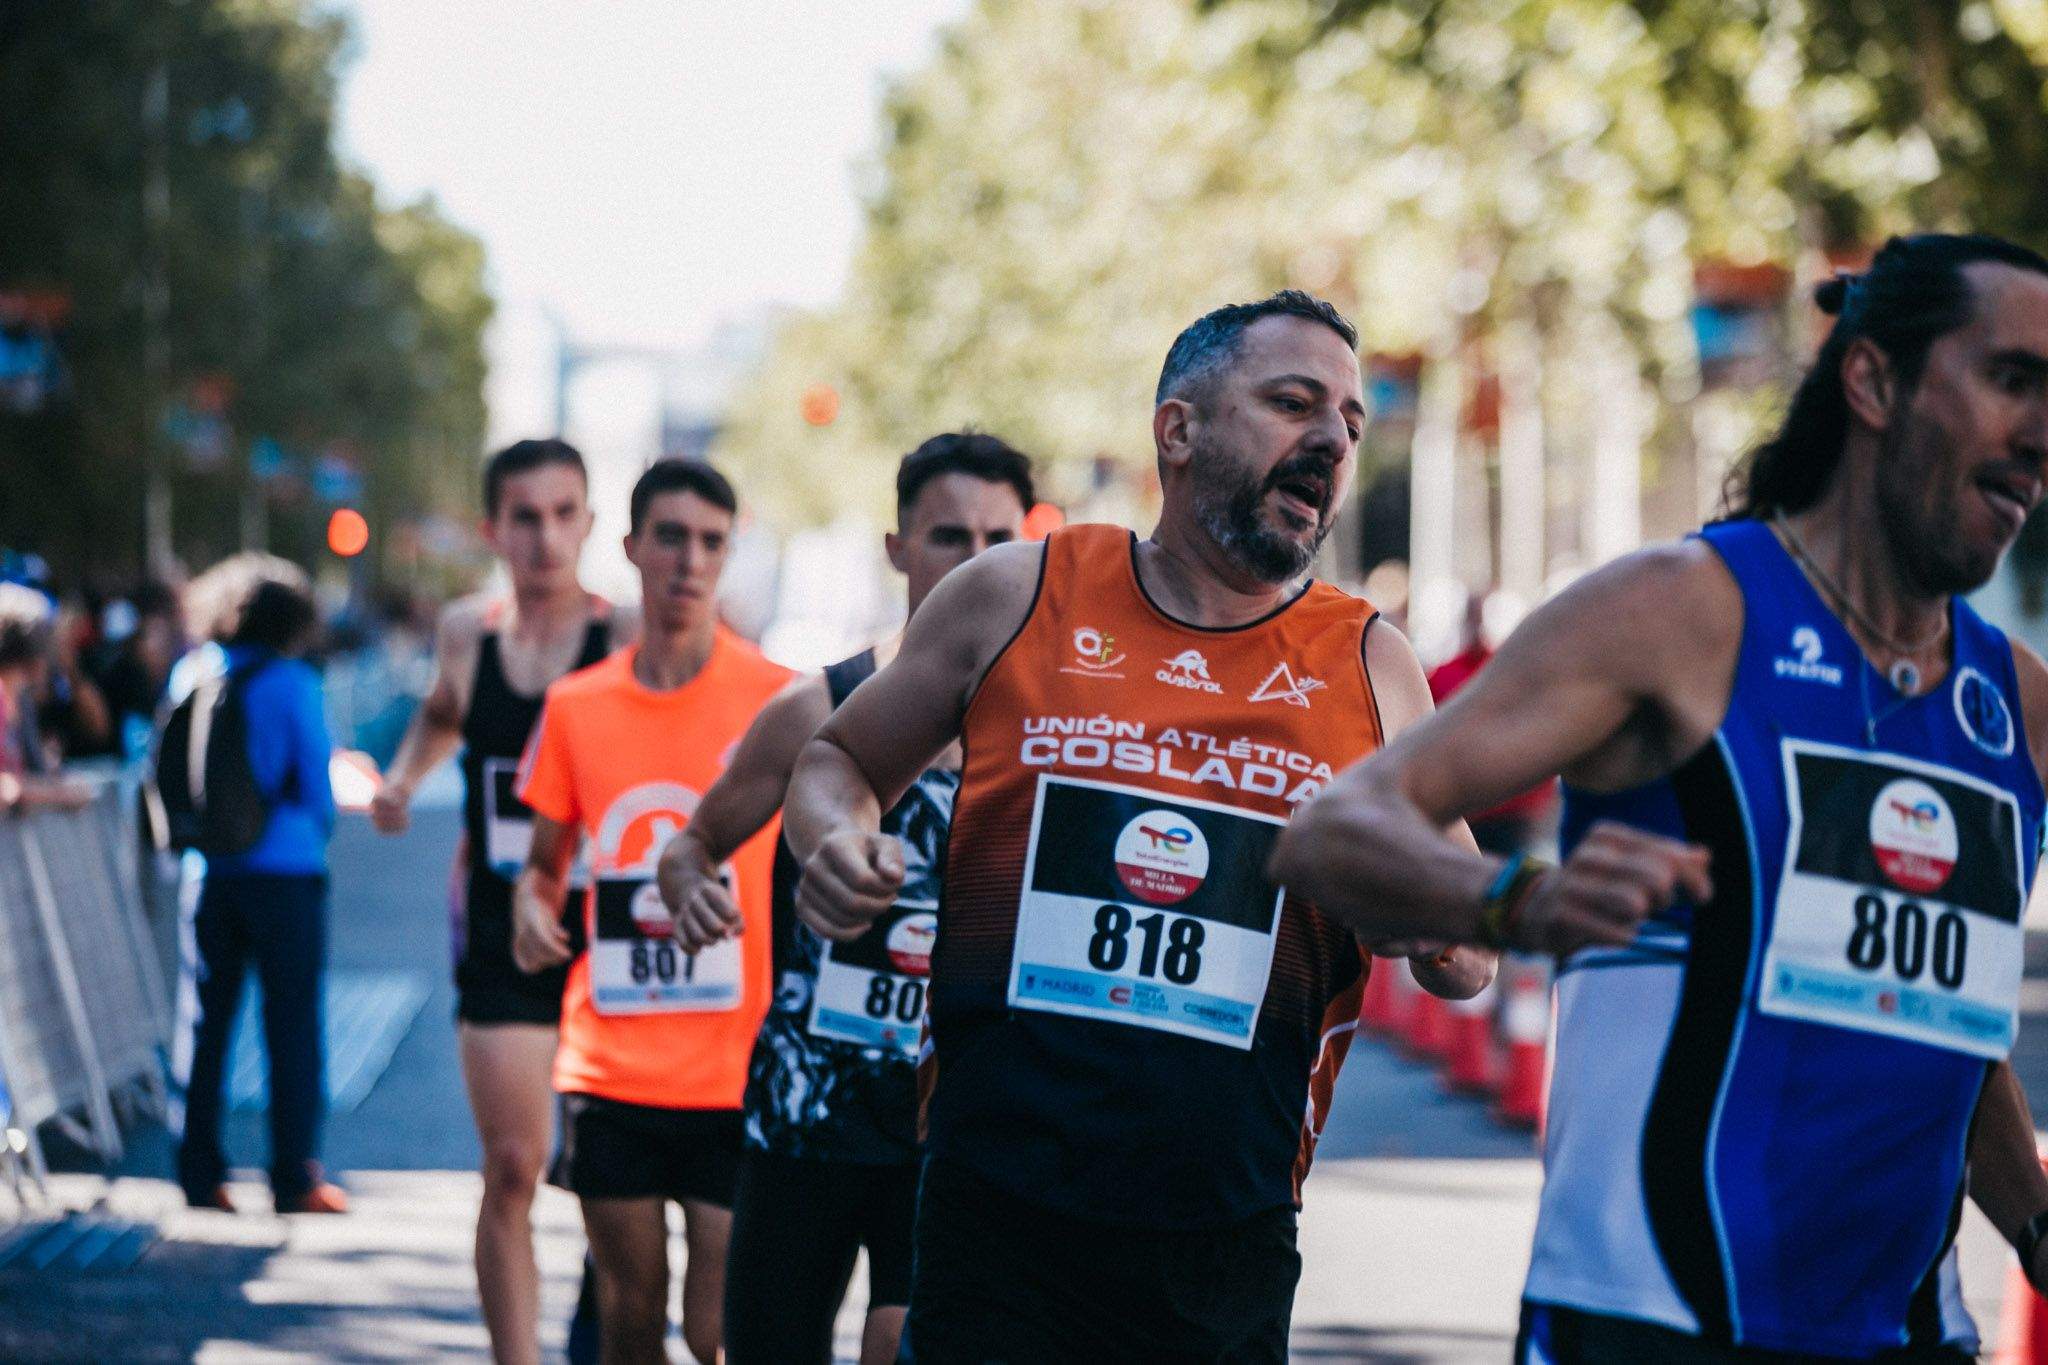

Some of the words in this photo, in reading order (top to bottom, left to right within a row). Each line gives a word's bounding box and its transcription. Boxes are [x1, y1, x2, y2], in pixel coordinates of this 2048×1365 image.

[1021, 737, 1321, 807] COSLADA
[1024, 714, 1145, 739] UNIÓN
[1157, 728, 1334, 784] ATLÉTICA
[1088, 904, 1205, 985] 818
[1847, 893, 1968, 992] 800
[865, 975, 924, 1024] 80
